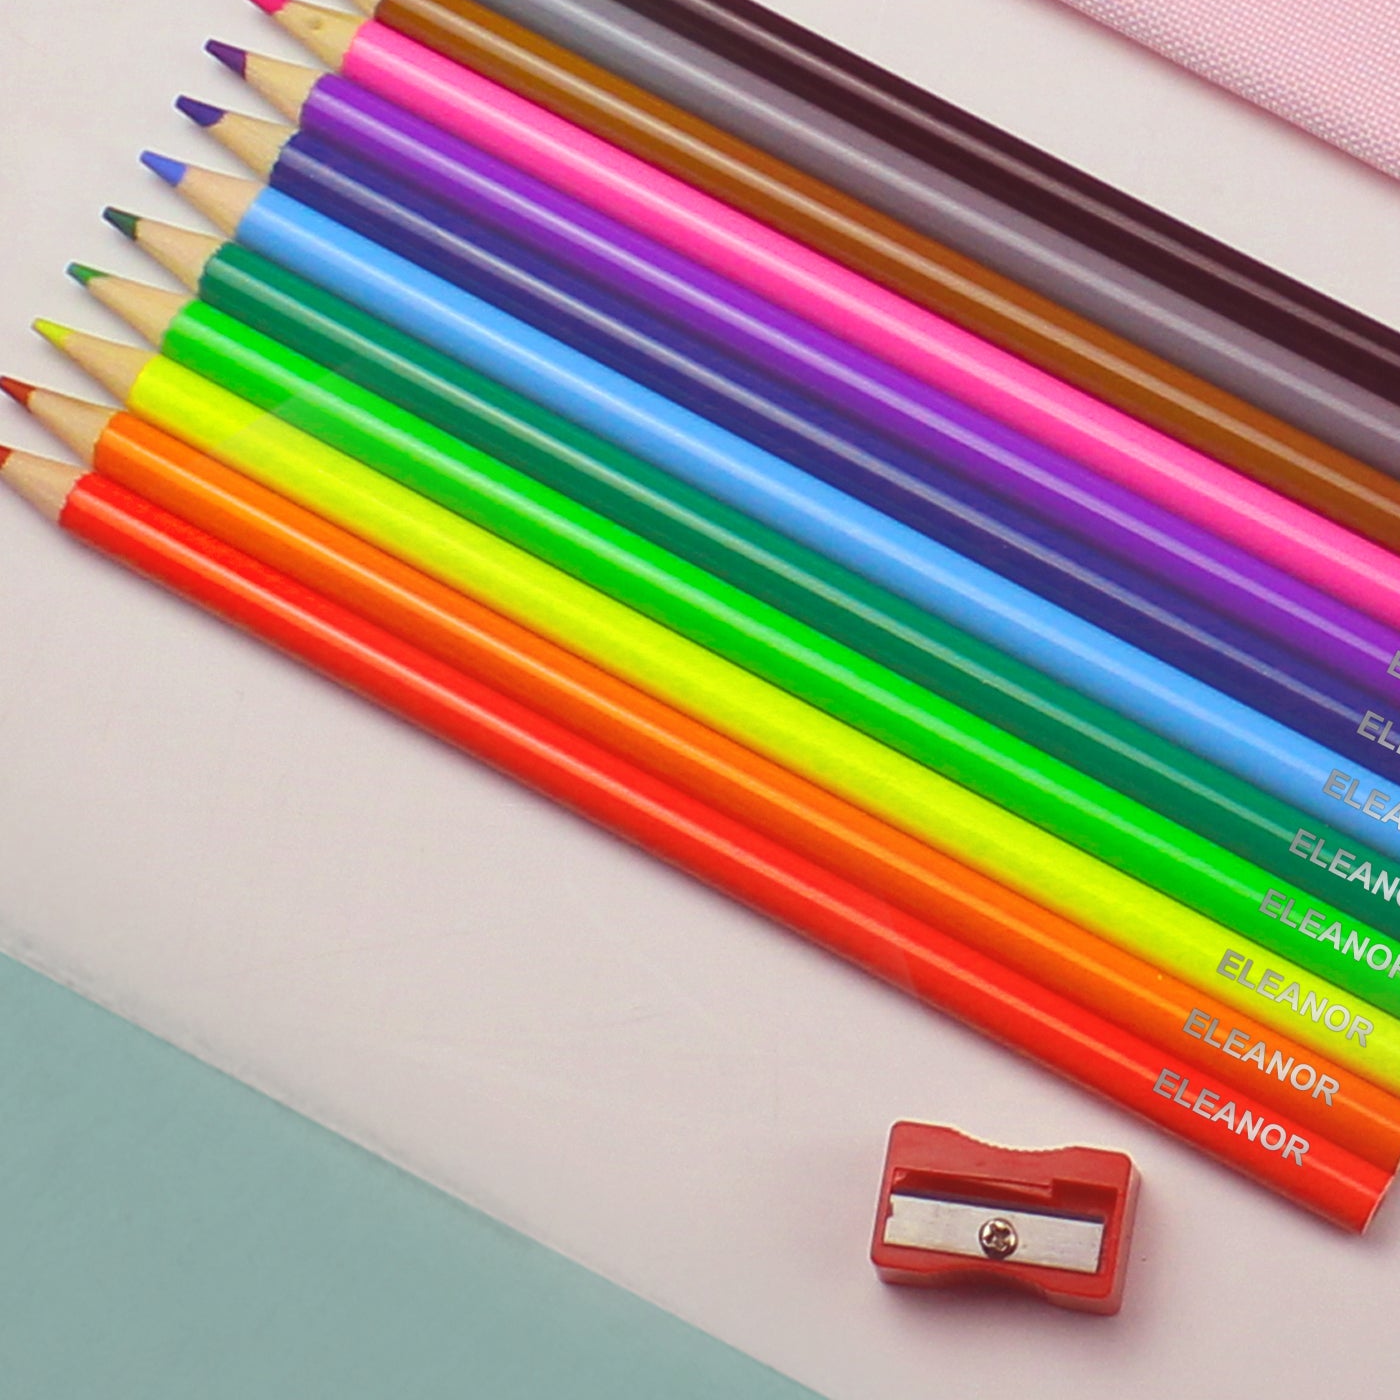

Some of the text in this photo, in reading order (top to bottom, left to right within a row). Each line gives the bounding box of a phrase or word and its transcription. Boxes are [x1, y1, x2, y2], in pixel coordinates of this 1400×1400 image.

[1216, 949, 1374, 1048] ELEANOR
[1183, 1008, 1340, 1106] ELEANOR
[1153, 1068, 1309, 1166] ELEANOR
